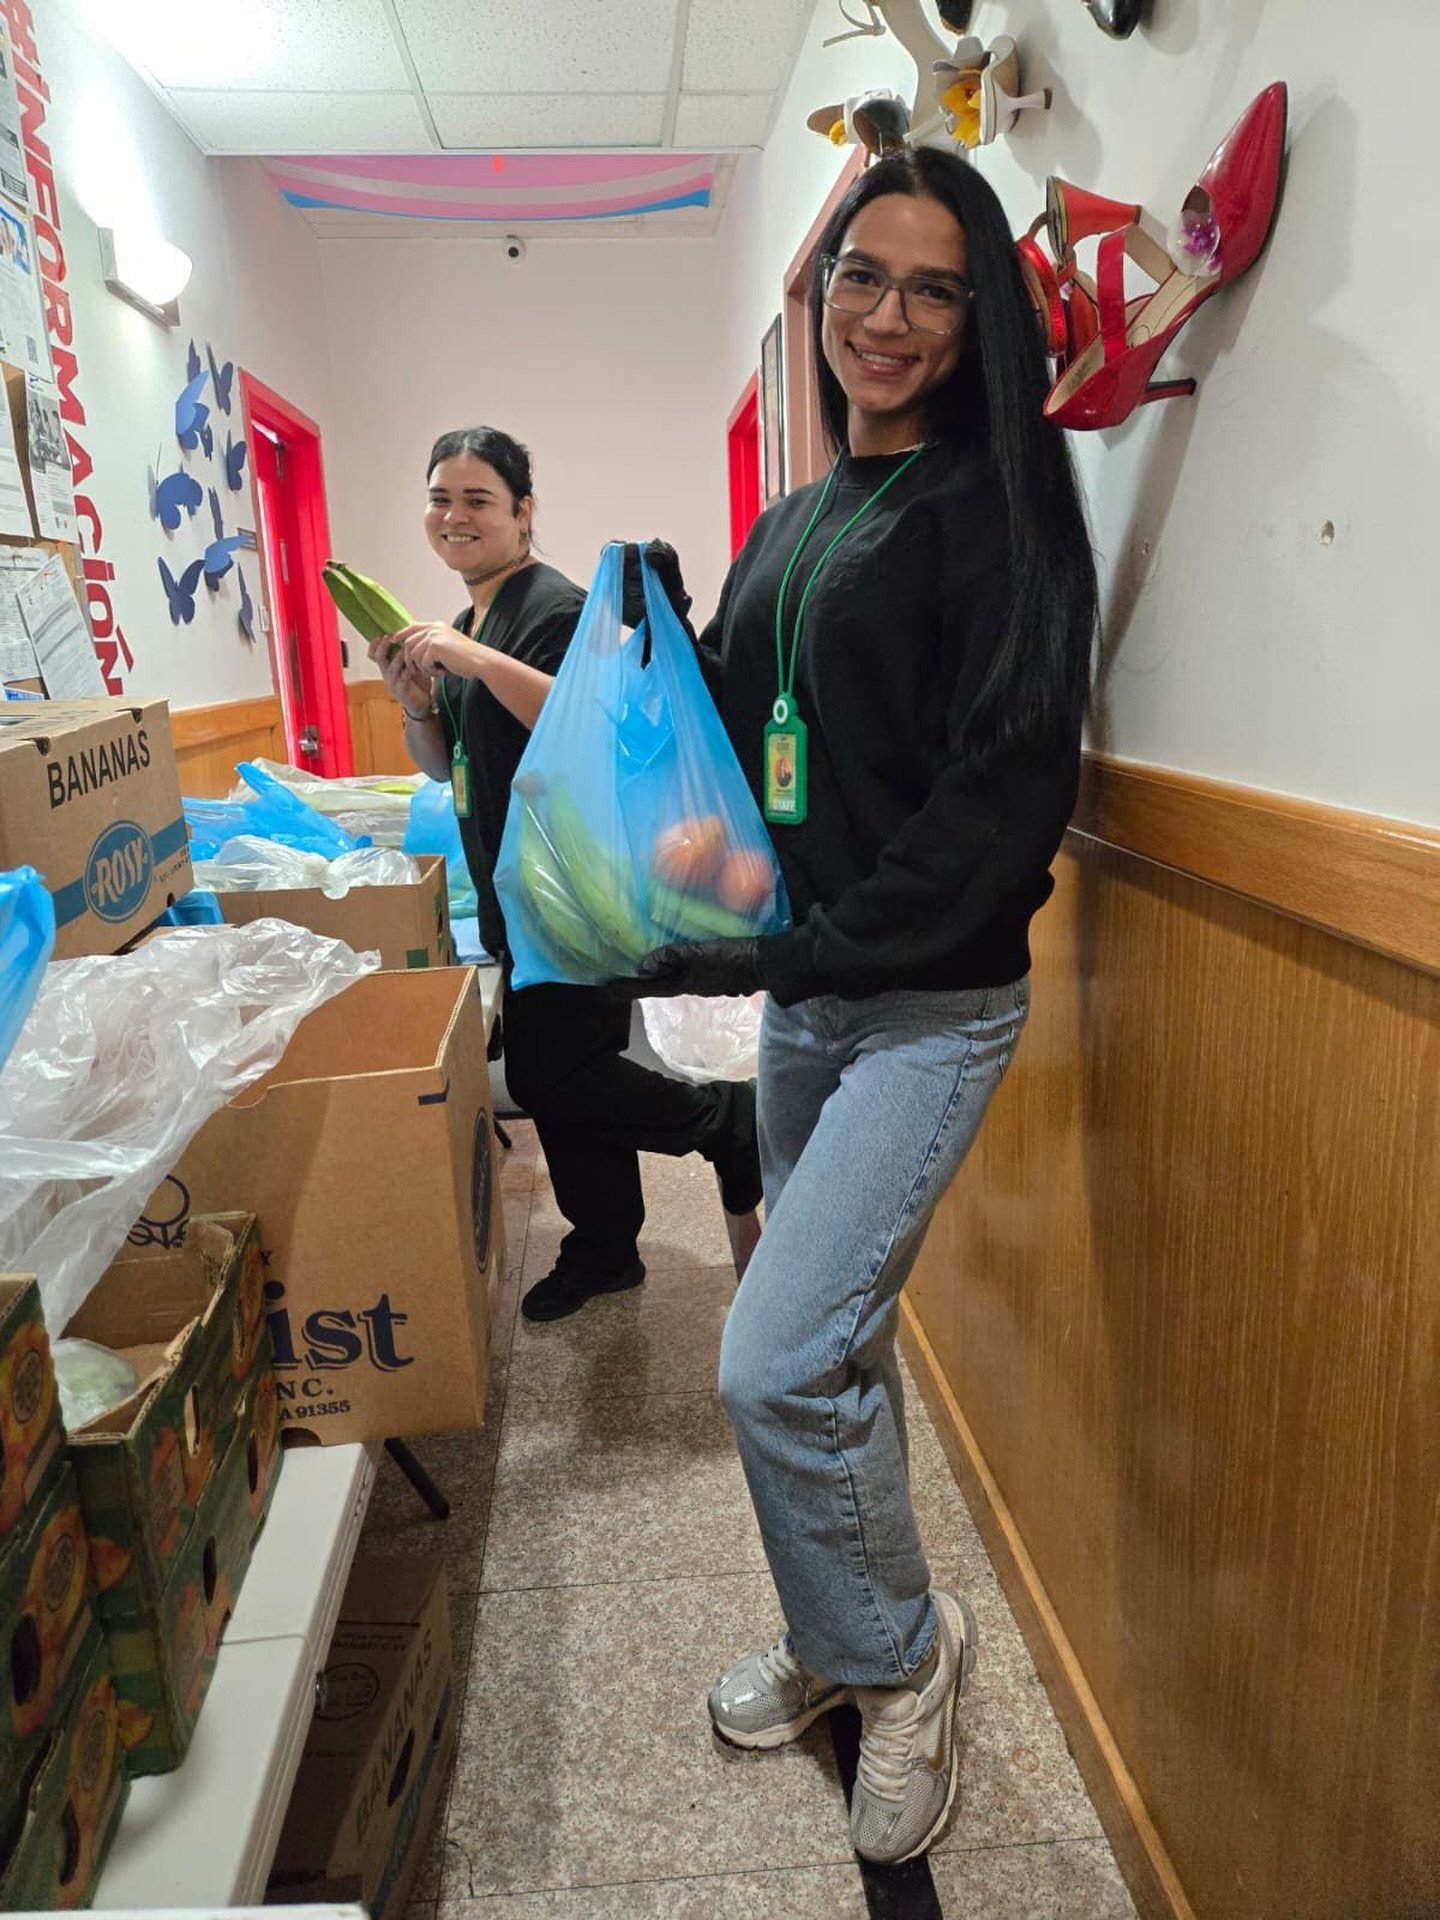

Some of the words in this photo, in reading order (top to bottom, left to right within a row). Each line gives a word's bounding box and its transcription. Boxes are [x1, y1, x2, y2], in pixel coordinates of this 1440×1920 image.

[47, 730, 151, 808] BANANAS
[92, 837, 148, 907] ROSY
[263, 1280, 414, 1372] ist
[274, 1378, 335, 1401] NC.
[278, 1406, 293, 1422] A
[295, 1399, 351, 1419] 91355
[356, 1627, 433, 1842] BANANAS
